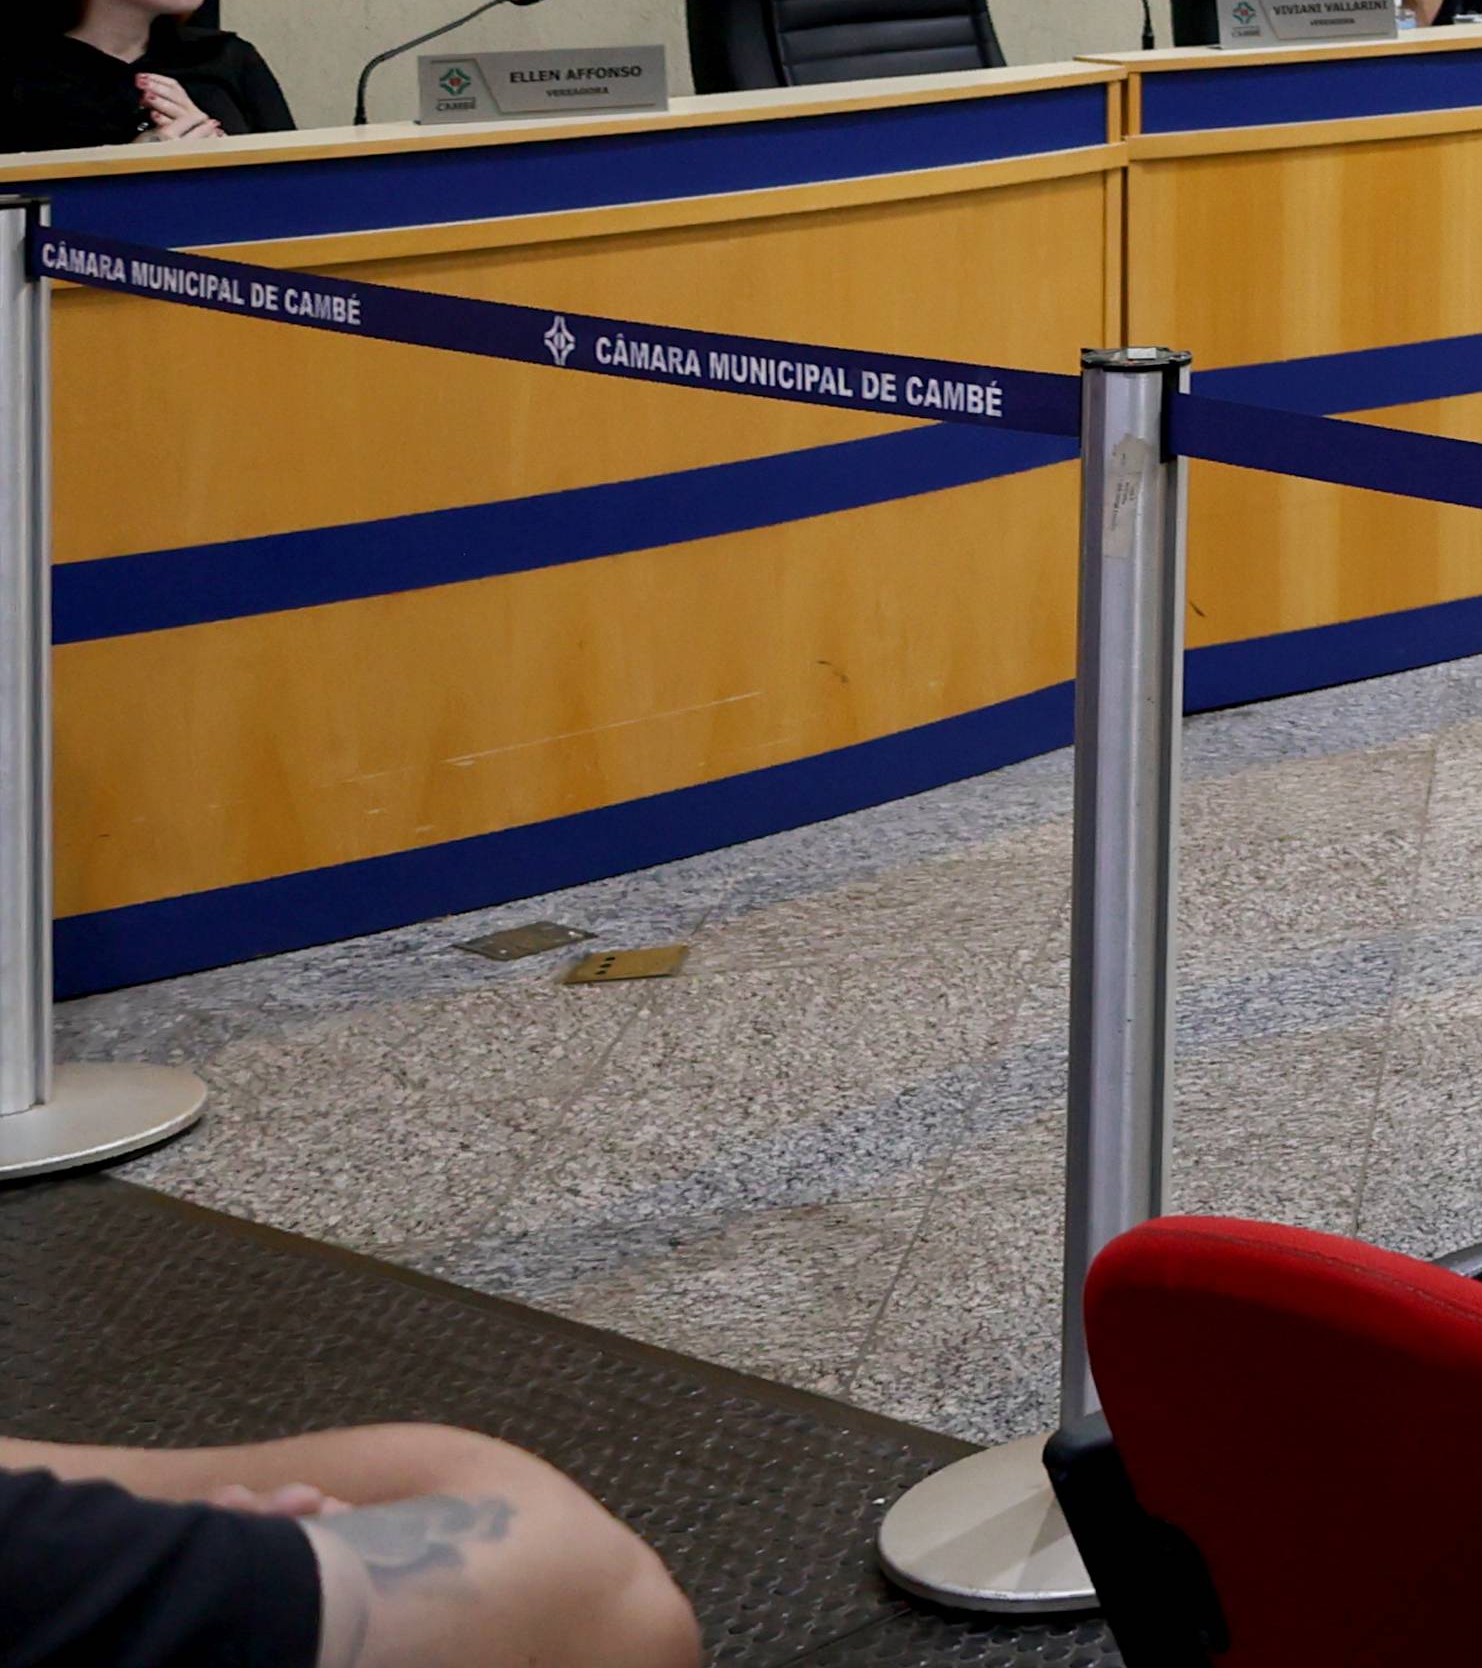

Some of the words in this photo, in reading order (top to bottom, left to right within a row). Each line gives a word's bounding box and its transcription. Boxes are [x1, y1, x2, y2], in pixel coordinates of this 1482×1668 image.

[1273, 3, 1323, 16] VIVIANI
[1324, 0, 1388, 14] VALLARINI
[509, 68, 561, 84] ELLEN
[566, 65, 643, 81] AFFONSO
[41, 240, 126, 284] CÂMARA
[131, 260, 245, 306] MUNICIPAL
[250, 282, 279, 311] DE
[284, 288, 362, 326] CAMBÉ
[595, 334, 702, 378] CÂMARA
[708, 351, 854, 398] MUNICIPAL
[861, 371, 898, 403] DE
[905, 376, 1004, 417] CAMBÉ
